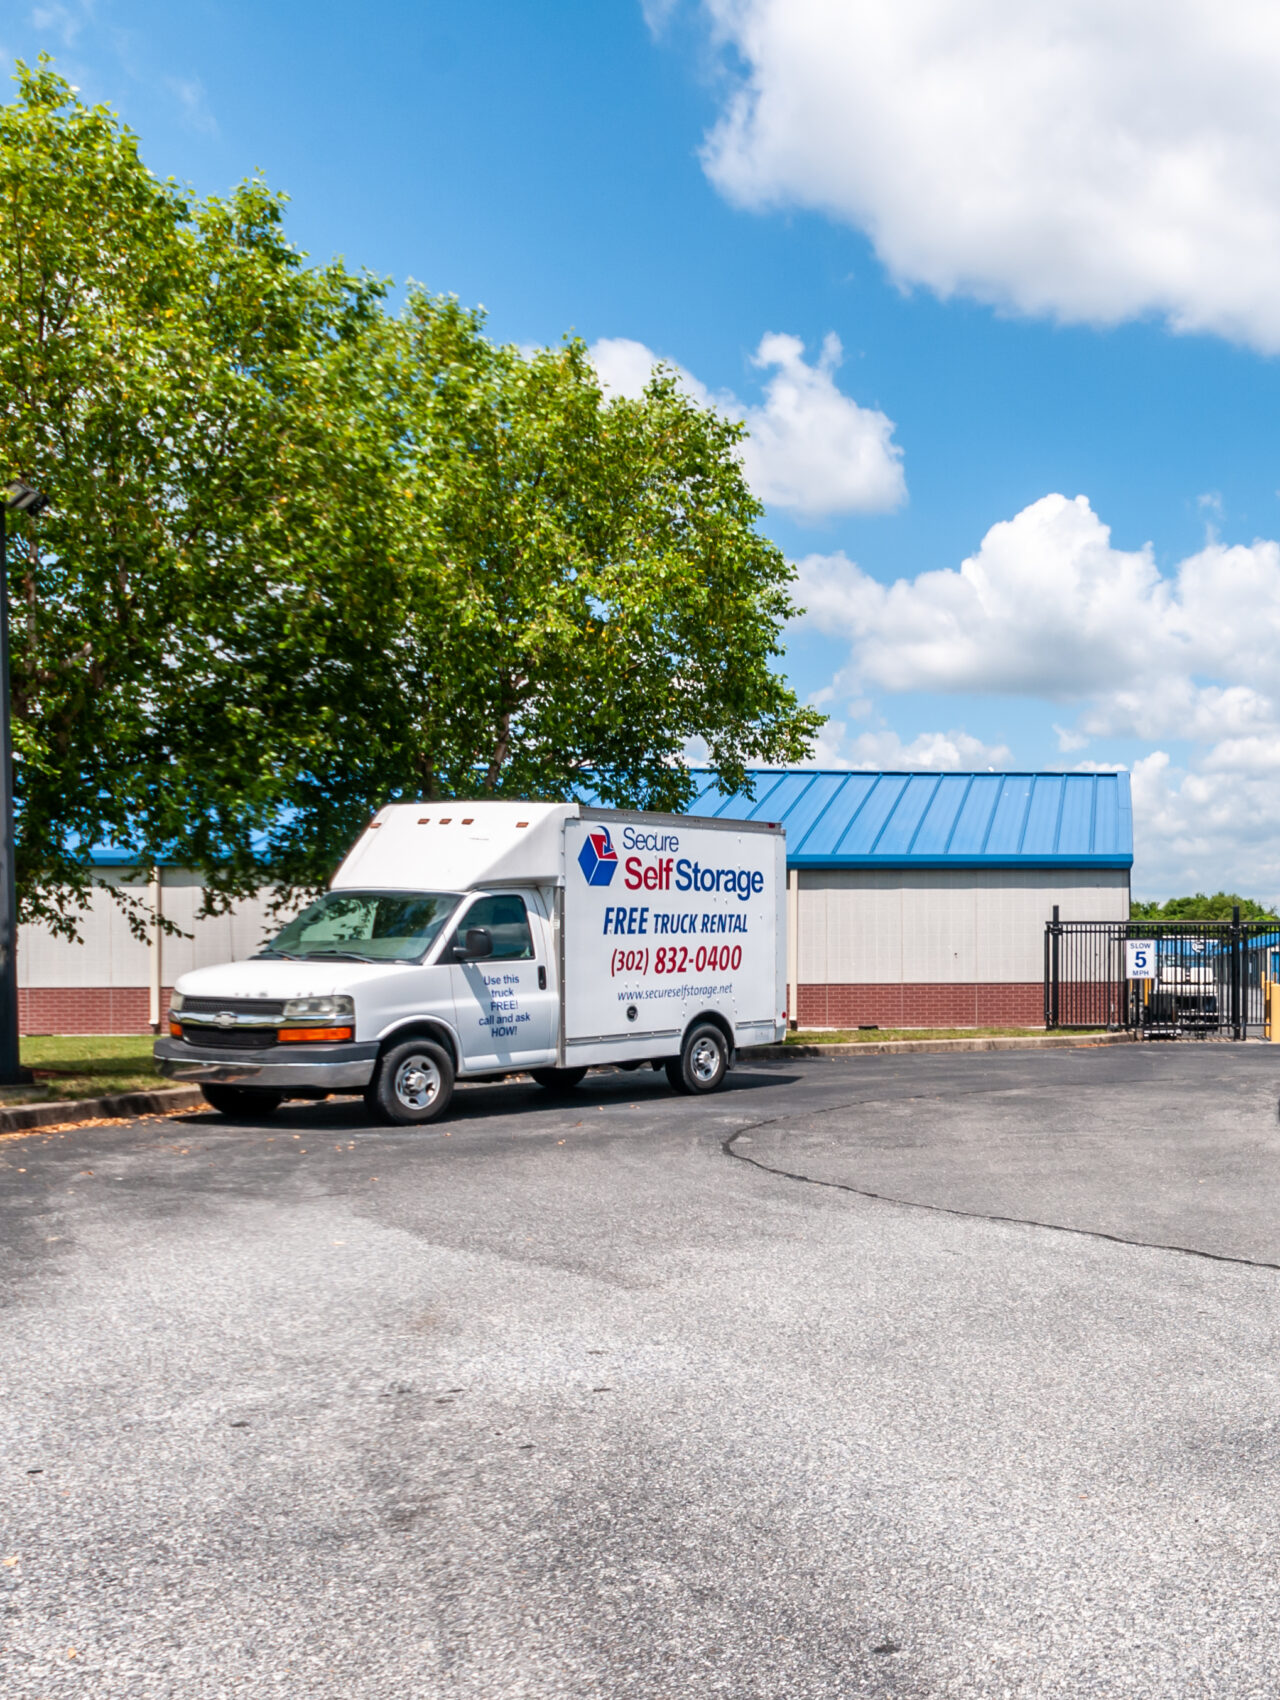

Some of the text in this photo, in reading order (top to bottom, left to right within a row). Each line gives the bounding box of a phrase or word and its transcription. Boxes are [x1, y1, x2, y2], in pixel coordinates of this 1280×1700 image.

[623, 827, 679, 852] Secure
[603, 906, 749, 935] FREE TRUCK RENTAL
[611, 944, 742, 977] (302) 832-0400
[1135, 951, 1147, 968] 5
[483, 974, 520, 986] Use this
[491, 987, 514, 998] truck
[617, 983, 733, 1001] www.secureselfstorage.net
[490, 1000, 519, 1011] FREE!
[478, 1011, 531, 1026] call and ask
[491, 1026, 518, 1037] HOW!
